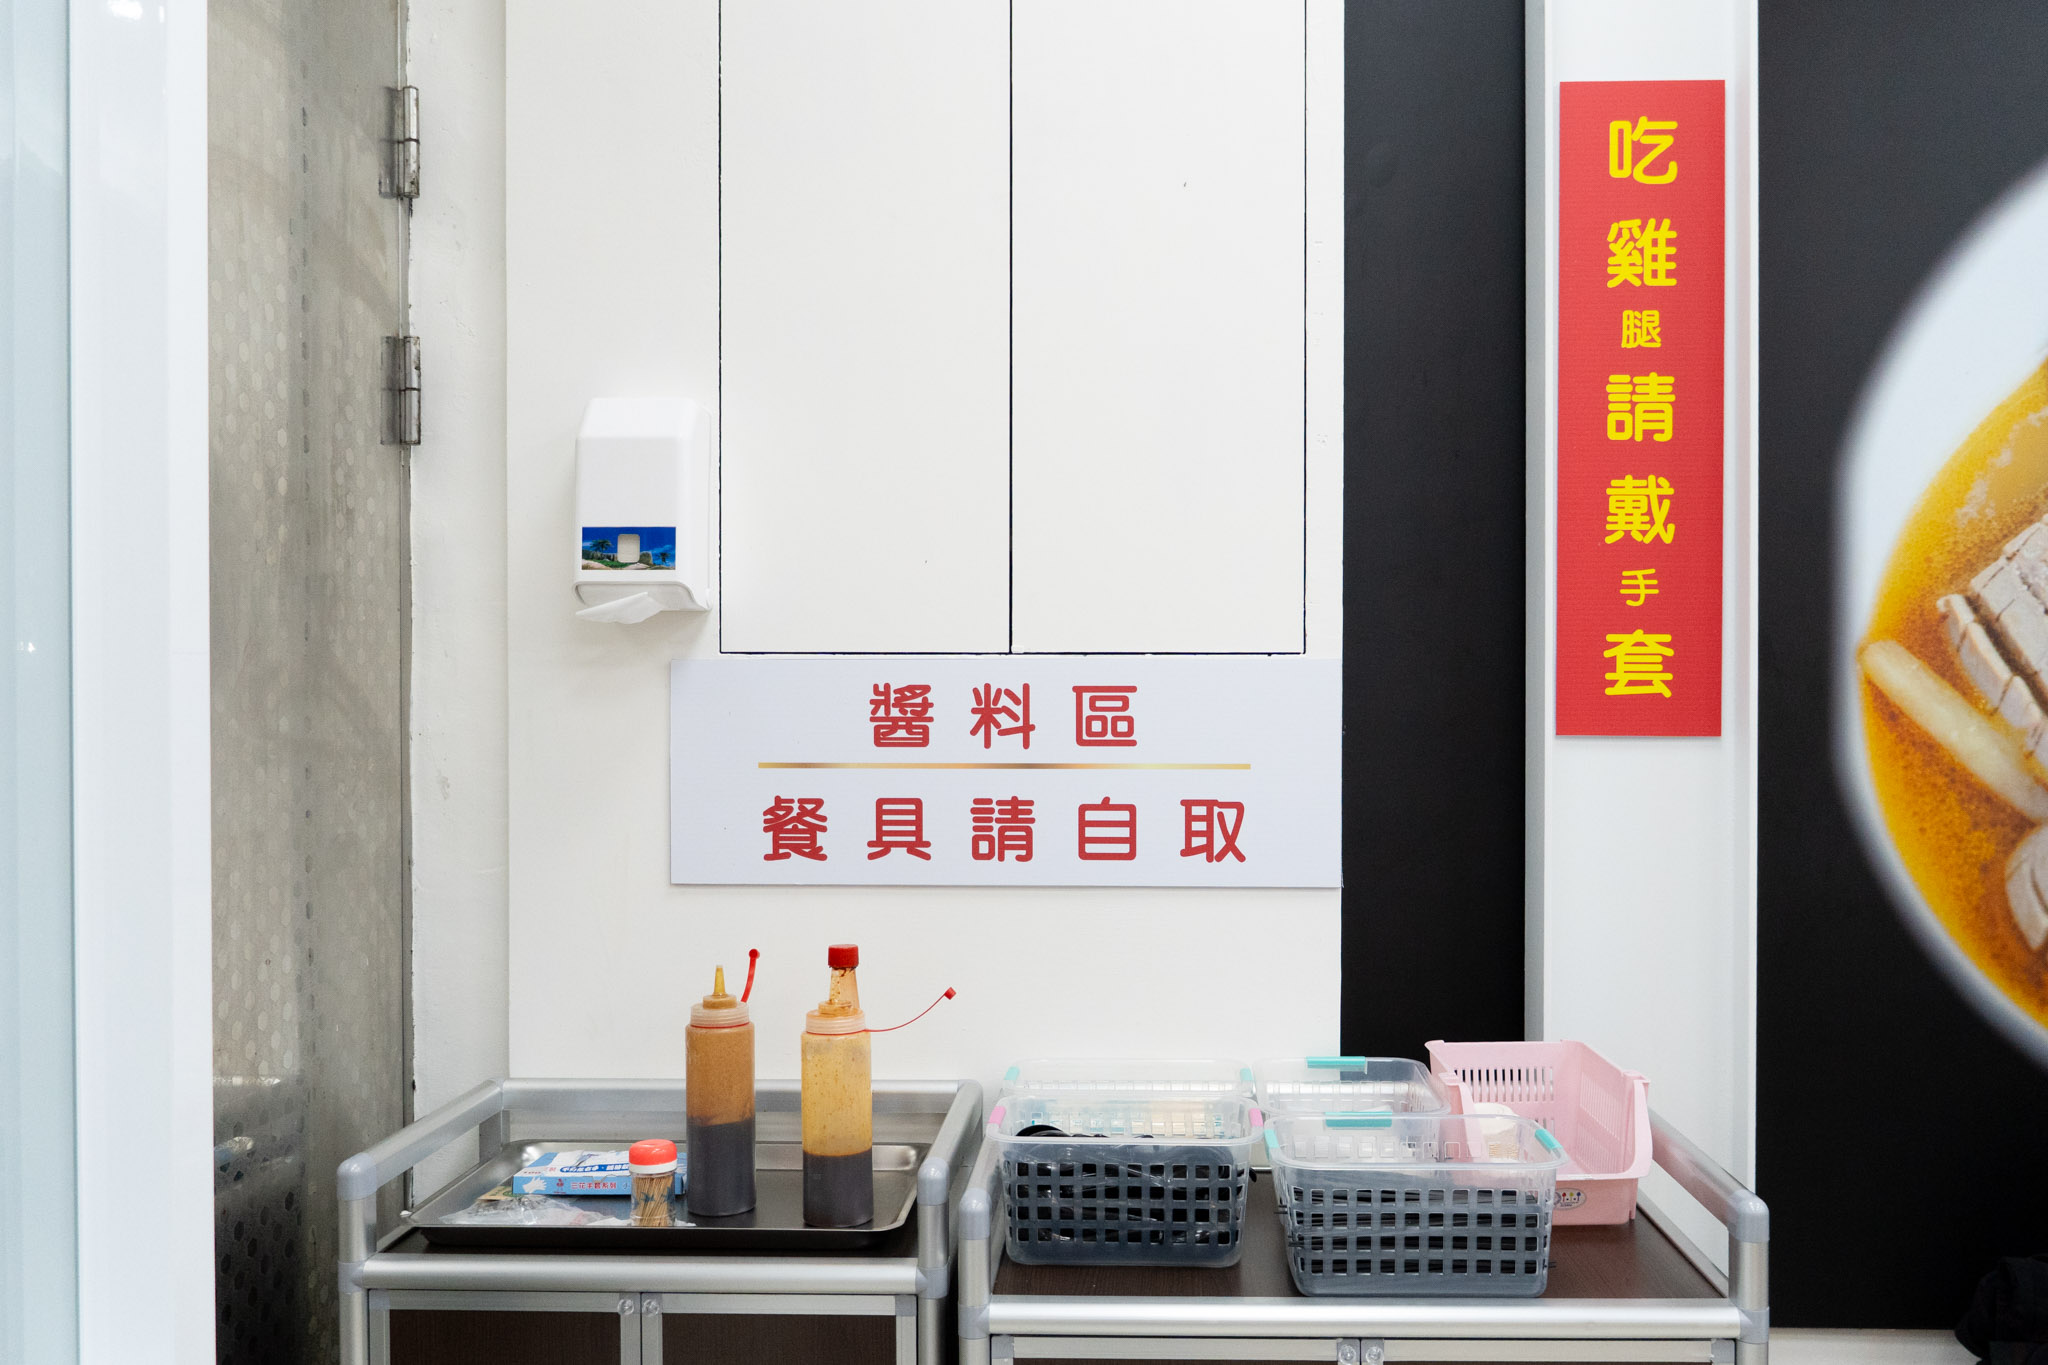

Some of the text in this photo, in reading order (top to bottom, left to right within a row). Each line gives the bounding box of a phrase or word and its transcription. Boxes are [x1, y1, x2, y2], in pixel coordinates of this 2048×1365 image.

[1603, 115, 1679, 698] 吃雞腿請戴手套
[869, 682, 1138, 750] 醬料區
[762, 795, 1246, 863] 餐具請自取
